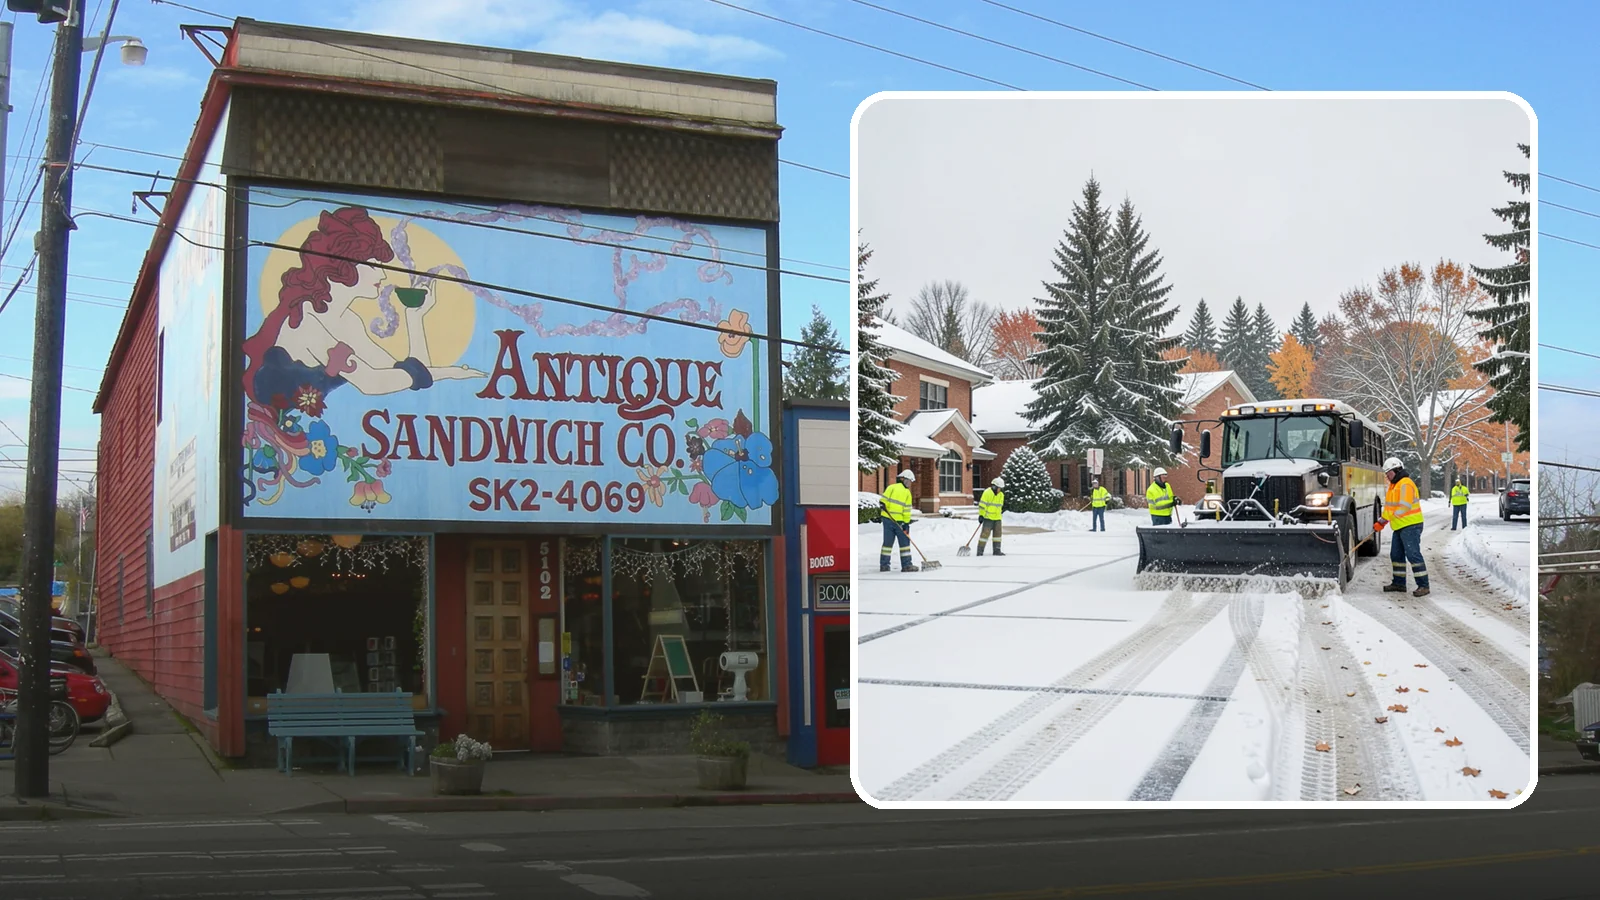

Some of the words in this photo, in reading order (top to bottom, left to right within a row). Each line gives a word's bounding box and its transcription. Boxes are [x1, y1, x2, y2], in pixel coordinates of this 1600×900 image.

[476, 329, 723, 421] ANTIQUE
[361, 408, 604, 467] SANDWICH
[617, 422, 684, 468] CO.
[468, 477, 645, 512] SK2-4069
[540, 542, 551, 600] 5102
[809, 555, 835, 568] BOOKS
